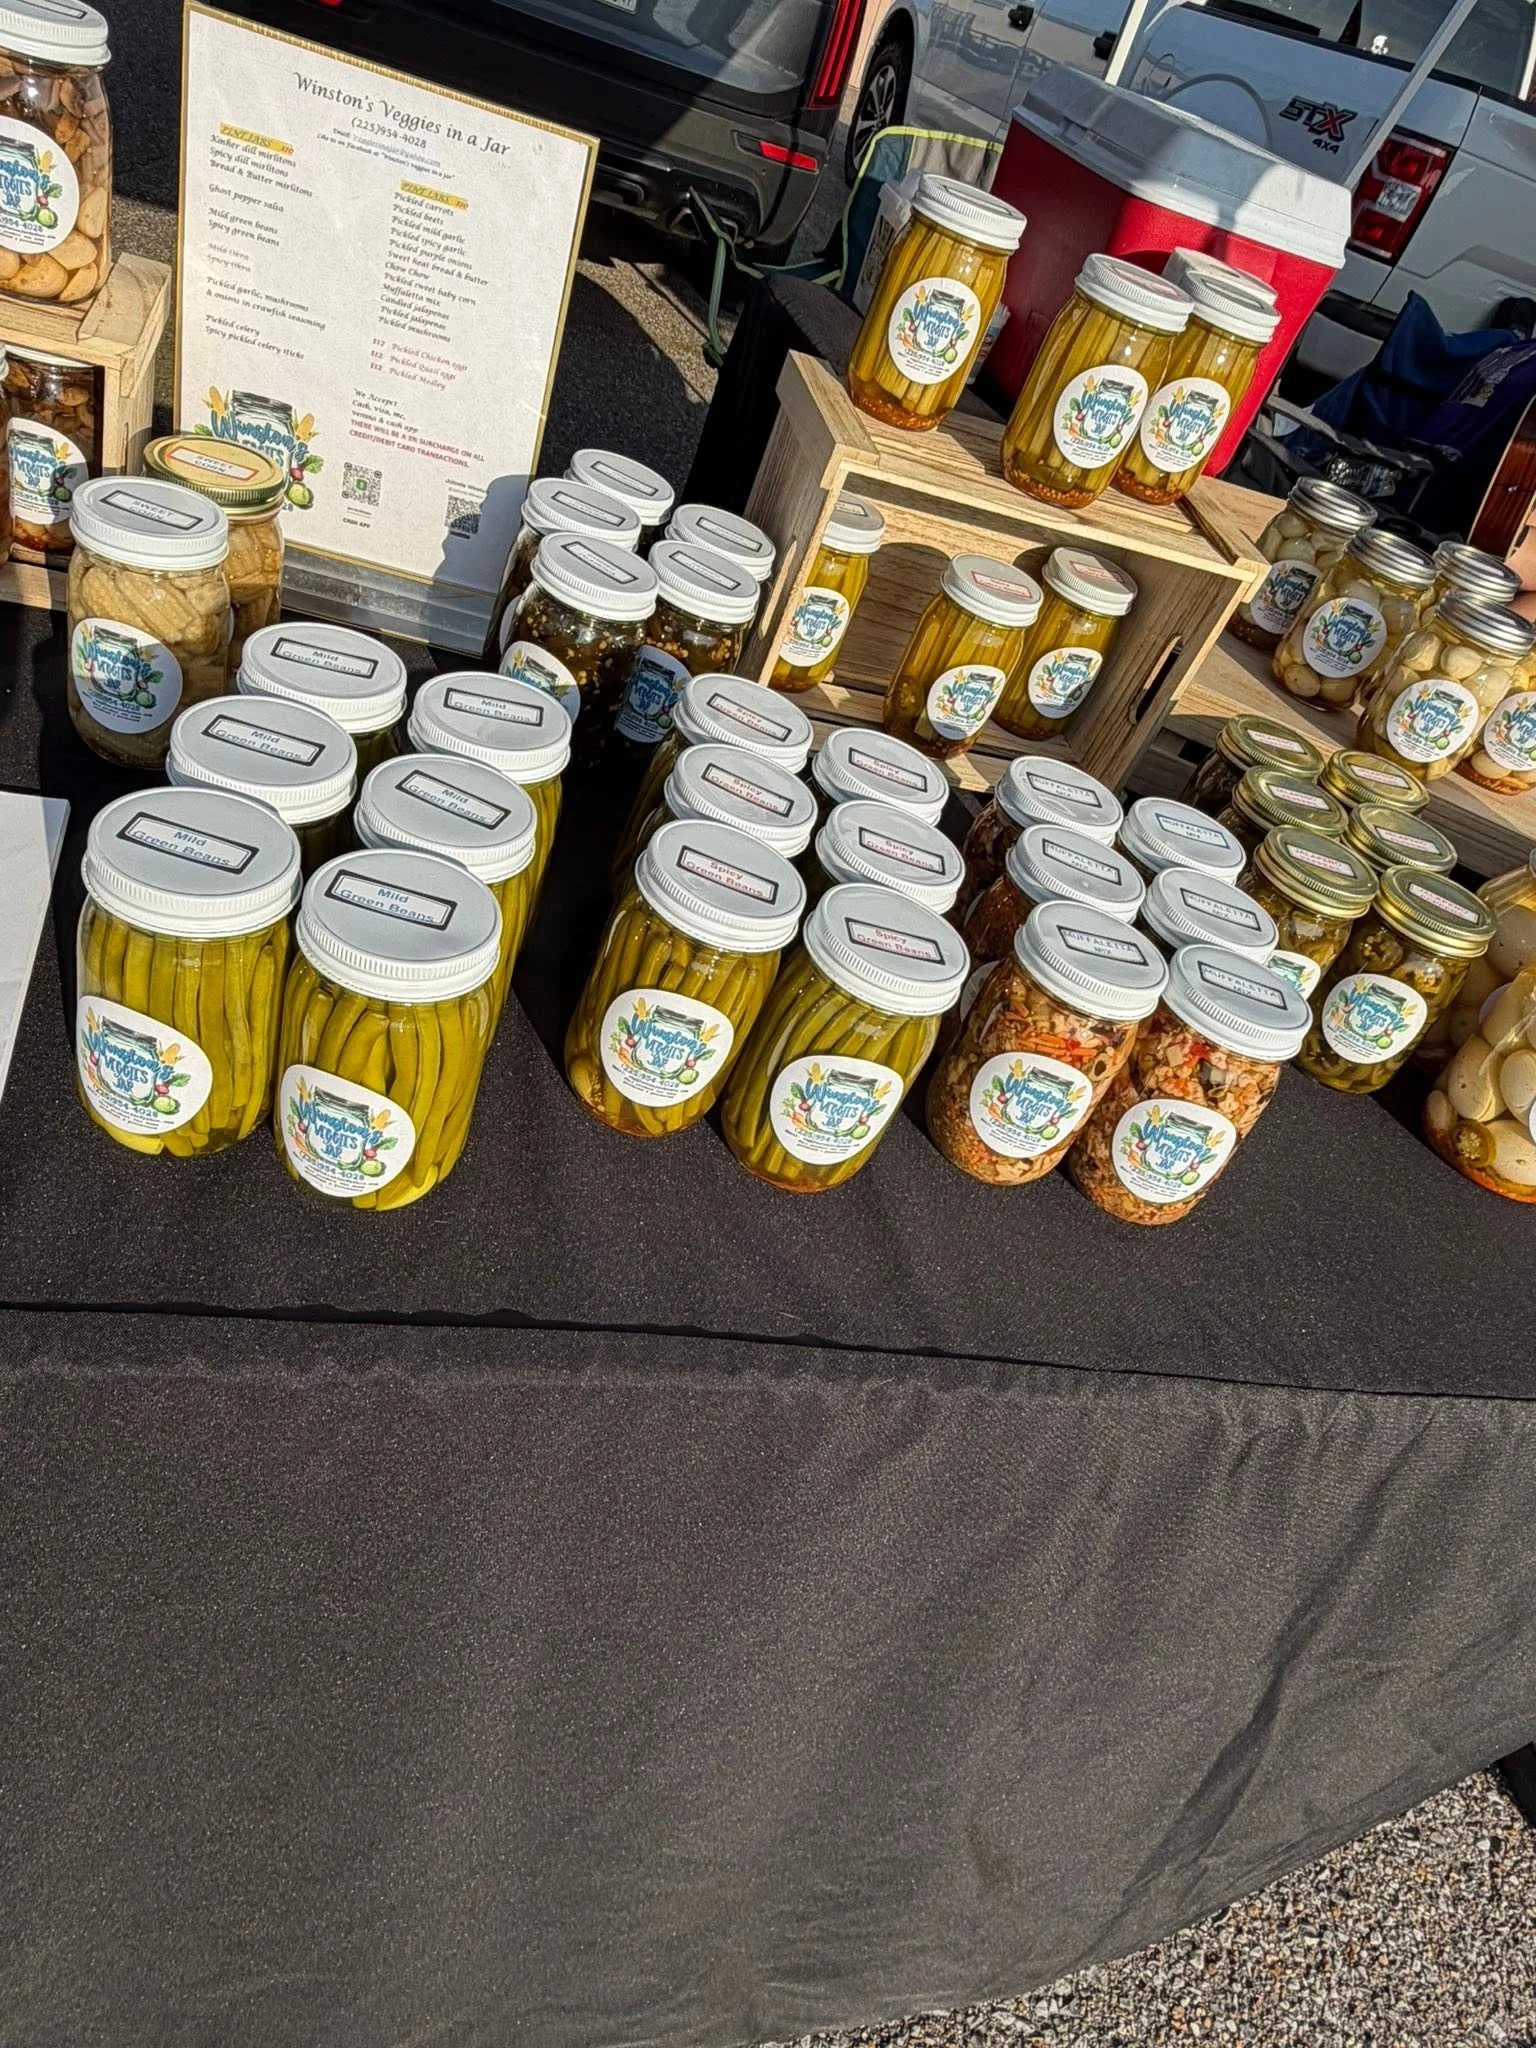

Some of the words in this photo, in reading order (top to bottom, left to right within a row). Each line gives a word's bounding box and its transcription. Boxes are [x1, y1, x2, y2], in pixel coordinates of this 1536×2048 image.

[293, 72, 374, 113] Winston's
[380, 100, 441, 134] Veggies
[446, 124, 463, 141] in
[467, 135, 477, 146] a
[480, 137, 511, 156] Jar
[1279, 95, 1358, 142] STX
[351, 117, 427, 149] (225)954-4028
[210, 147, 233, 161] Spicy
[234, 155, 249, 165] dill
[242, 144, 257, 155] dill
[210, 159, 235, 173] Bread
[237, 167, 244, 176] &
[246, 170, 273, 185] Butter
[208, 184, 232, 196] Ghost
[232, 191, 261, 205] pepper
[264, 200, 284, 213] salsa
[394, 191, 424, 207] Pickled
[424, 202, 454, 216] carrots
[208, 207, 230, 220] Mild
[230, 215, 253, 228] green
[255, 221, 278, 234] beans
[392, 203, 423, 218] Pickled
[424, 212, 444, 226] beets
[208, 219, 231, 233] Spicy
[231, 227, 255, 240] green
[257, 233, 280, 247] beans
[390, 227, 421, 242] Pickled
[442, 245, 467, 257] garlic
[391, 215, 423, 230] Pickled
[423, 225, 442, 237] mild
[441, 232, 466, 245] garlic
[388, 250, 410, 263] Sweet
[431, 264, 456, 276] bread
[456, 270, 462, 278] &
[464, 274, 488, 286] butter
[389, 239, 418, 253] Pickled
[419, 248, 446, 262] purple
[447, 257, 473, 270] onions
[385, 261, 407, 273] Chow
[408, 268, 430, 280] Chow
[206, 276, 237, 291] Pickled
[265, 295, 309, 312] mushrooms
[384, 272, 413, 287] Pickled
[437, 288, 456, 302] baby
[214, 292, 240, 304] onions
[252, 303, 286, 318] crawfish
[288, 313, 326, 331] seasoning
[380, 294, 413, 309] Candied
[381, 306, 410, 319] Pickled
[206, 314, 234, 328] Pickled
[236, 323, 260, 337] celery
[378, 316, 407, 330] Pickled
[205, 325, 227, 339] Spicy
[227, 332, 256, 346] pickled
[257, 341, 281, 355] celery
[392, 343, 420, 357] Pickled
[389, 367, 418, 381] Pickled
[390, 355, 418, 368] Pickled
[210, 409, 309, 462] Winston's
[397, 442, 416, 453] CARD
[419, 438, 459, 455] SURCHARGE
[461, 450, 472, 459] ON
[473, 453, 485, 462] ALL
[283, 651, 320, 665] Green
[324, 660, 362, 674] Beans
[313, 650, 339, 661] Mild
[216, 729, 256, 747] Green
[260, 742, 301, 760] Beans
[251, 730, 281, 743] Mild
[408, 783, 446, 806] Green
[449, 801, 487, 823] Beans
[442, 787, 470, 804] Mild
[134, 829, 180, 853] Green
[183, 843, 231, 867] Beans
[173, 829, 208, 848] Mild
[885, 839, 915, 856] Spicy
[866, 840, 897, 857] Green
[899, 852, 934, 870] Beans
[686, 860, 723, 880] Green
[727, 877, 764, 897] Beans
[710, 861, 744, 880] Spicy
[340, 888, 385, 911] Green
[388, 902, 435, 924] Beans
[377, 887, 410, 904] Mild
[856, 933, 891, 952] Green
[895, 943, 931, 960] Beans
[875, 928, 908, 945] Spicy
[631, 1013, 708, 1055] Winston's
[88, 1024, 175, 1080] Winston's
[300, 1095, 384, 1145] Winston's
